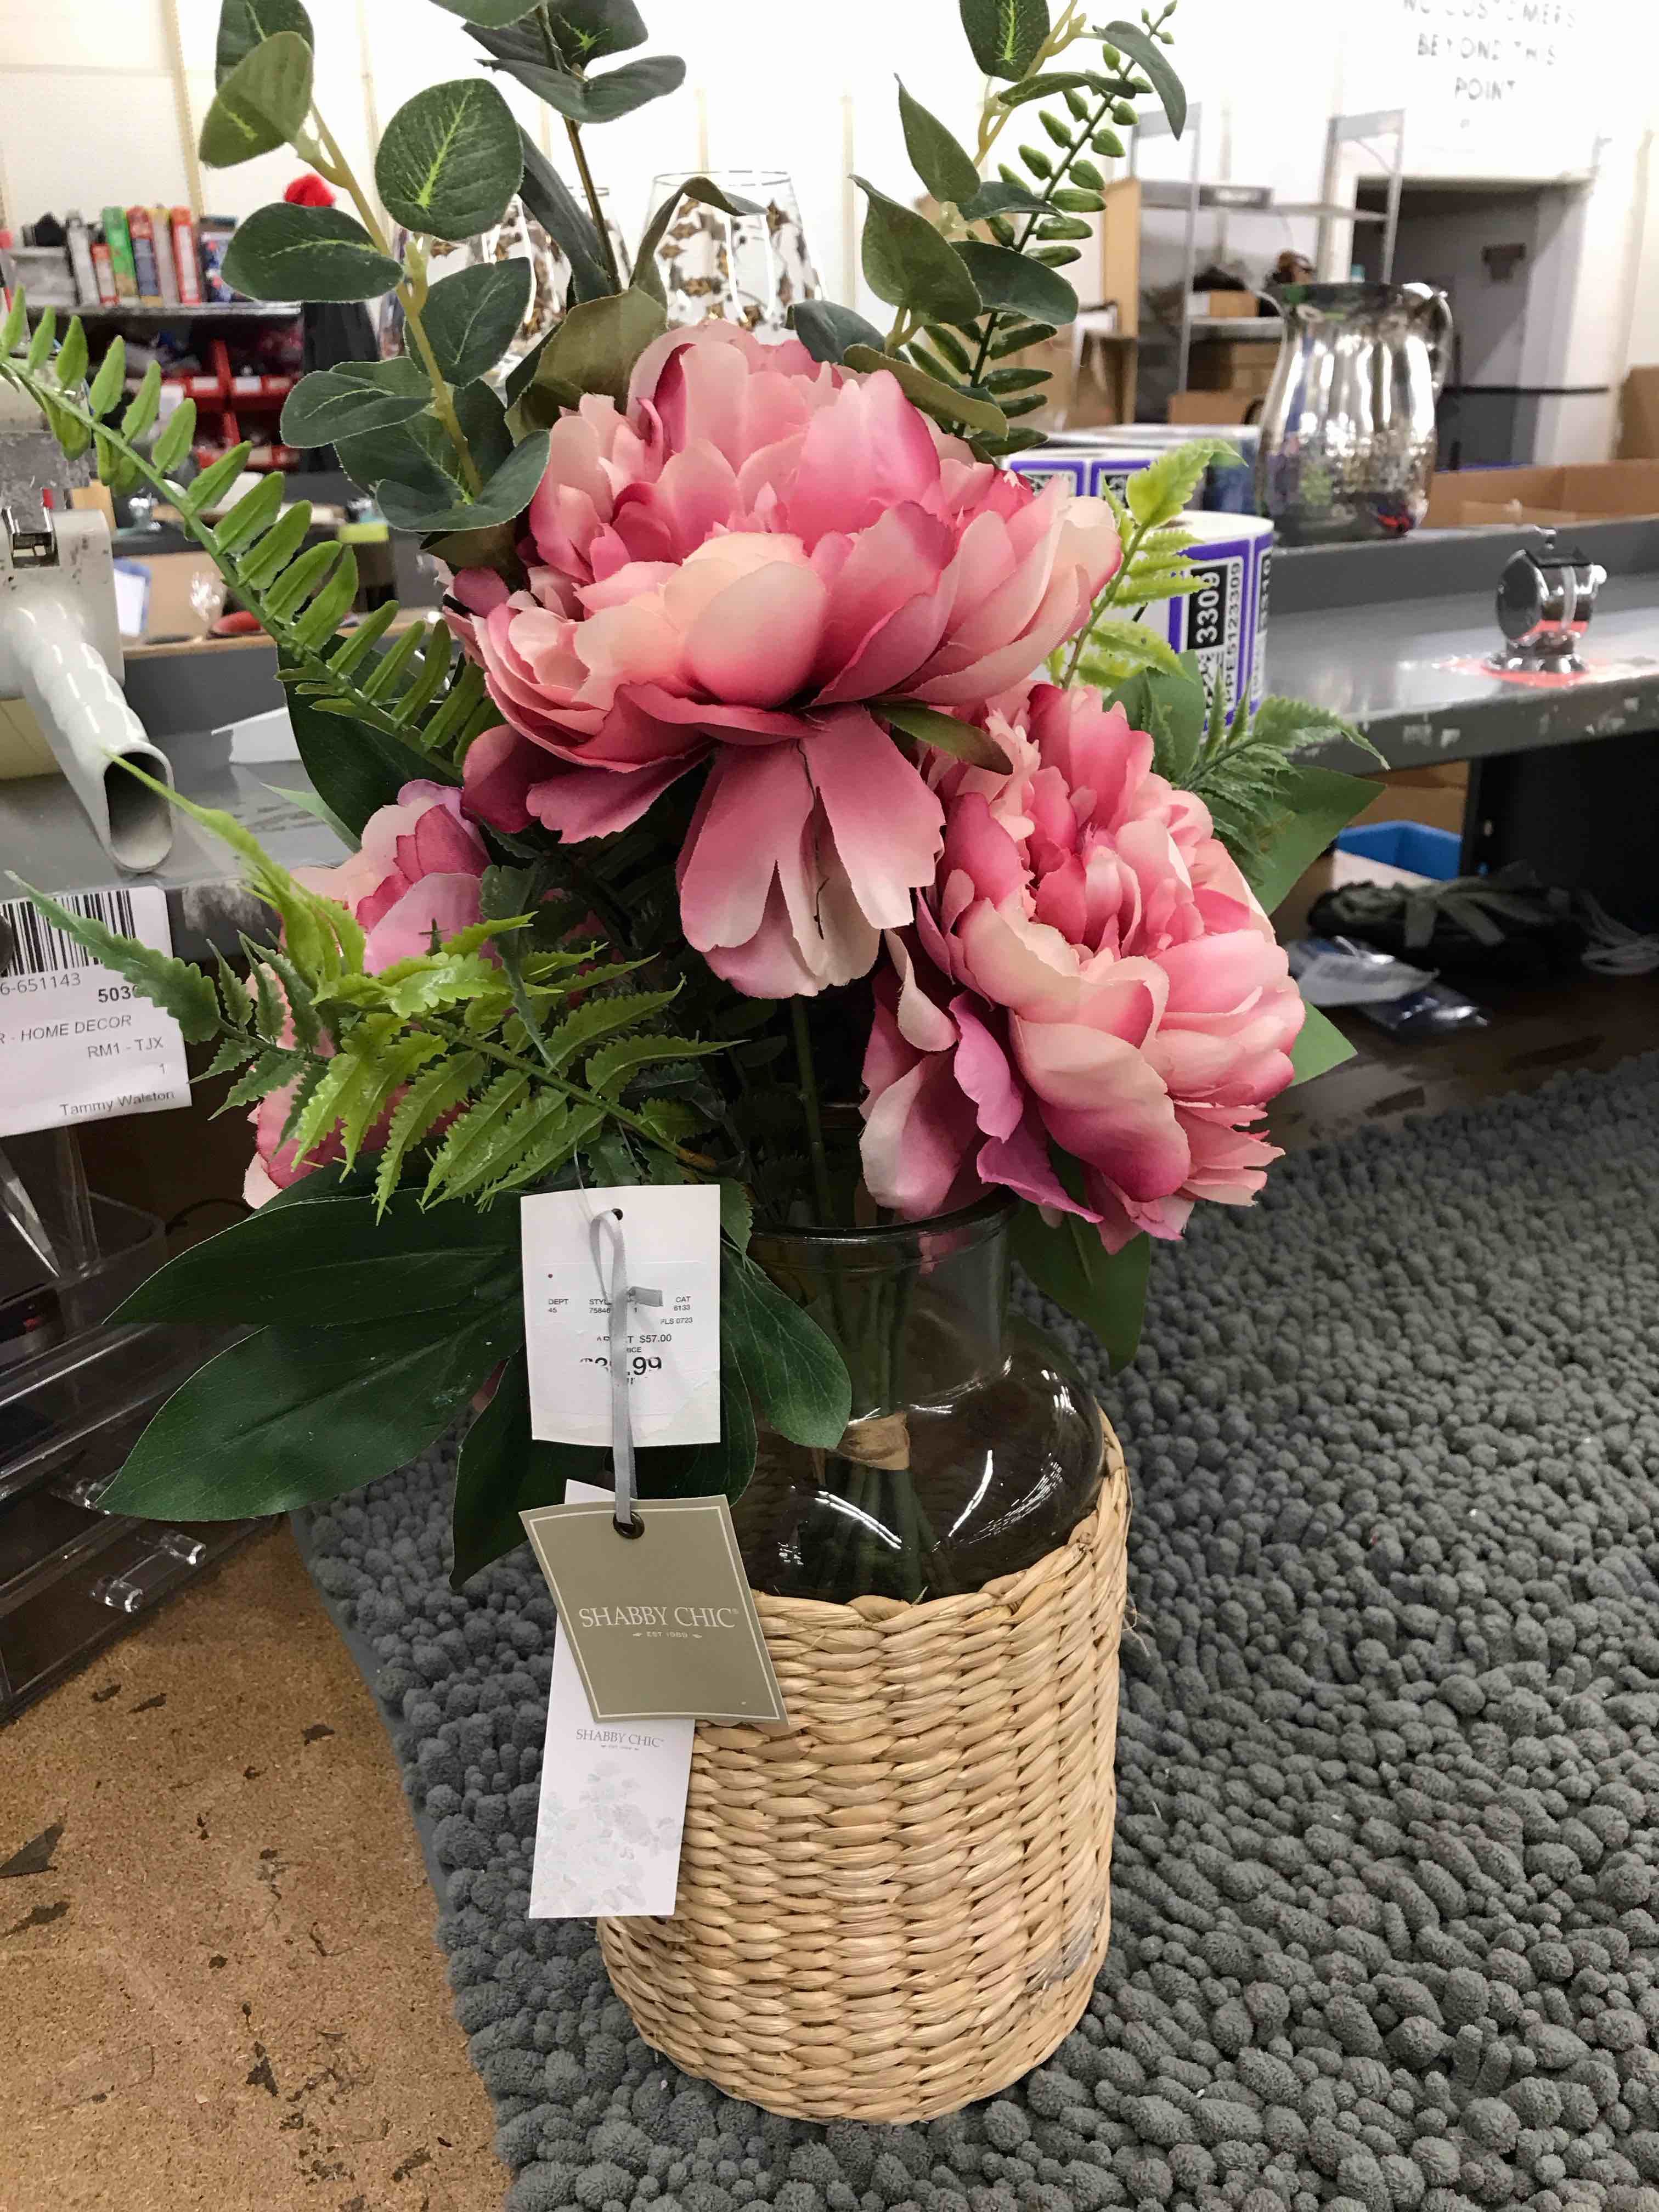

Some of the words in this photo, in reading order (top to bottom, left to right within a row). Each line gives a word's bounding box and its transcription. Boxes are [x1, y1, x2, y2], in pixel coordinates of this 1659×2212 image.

[1454, 76, 1516, 100] POINT
[1196, 572, 1221, 644] 3309
[98, 984, 141, 1003] 503
[21, 1023, 69, 1042] HOME
[75, 1014, 132, 1034] DECOR
[88, 1042, 120, 1058] RM1
[134, 1036, 165, 1052] TJX
[59, 1099, 114, 1116] Tammy
[117, 1090, 175, 1108] Walston
[639, 1334, 672, 1344] $57.00
[579, 1606, 669, 1628] SHABBY
[576, 1729, 625, 1743] SHABBY
